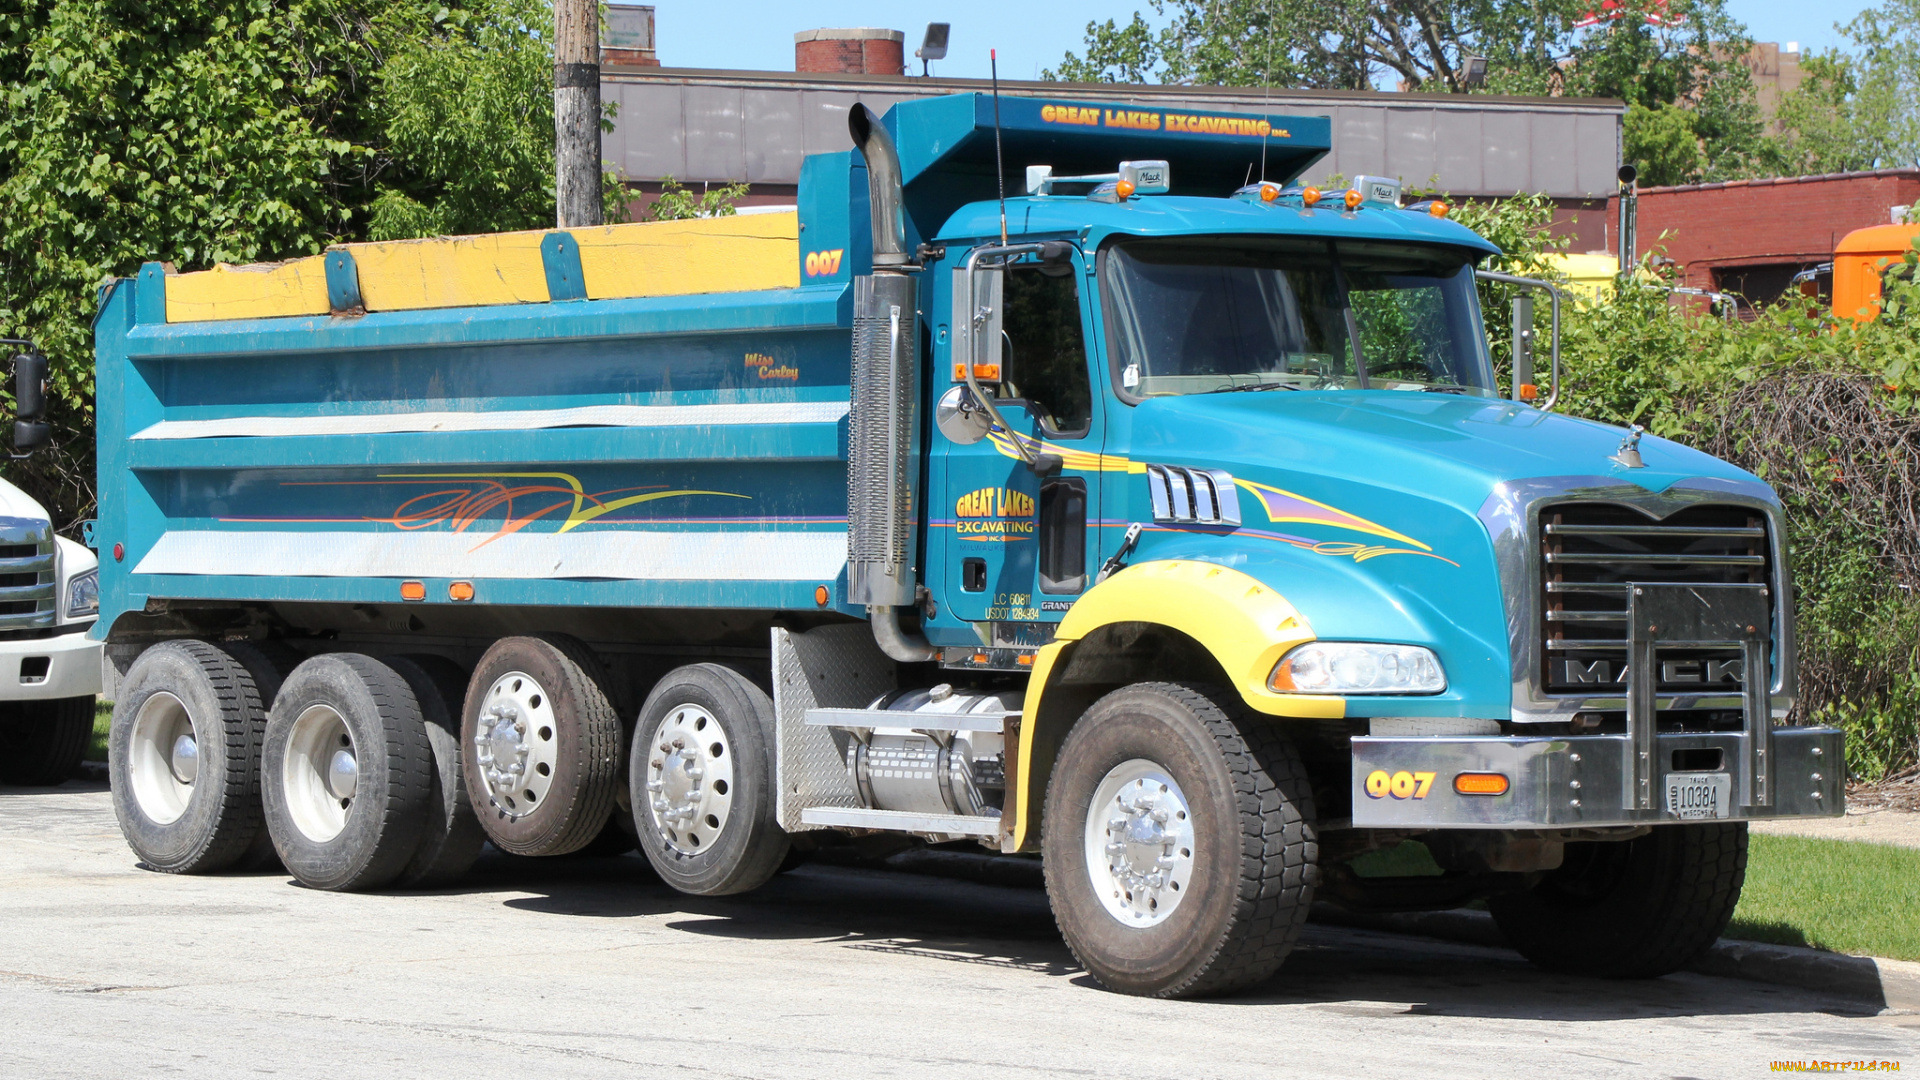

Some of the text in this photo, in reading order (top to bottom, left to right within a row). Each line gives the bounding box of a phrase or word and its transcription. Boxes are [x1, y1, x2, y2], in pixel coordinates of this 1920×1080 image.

[1041, 104, 1291, 138] GREAT LAKES EXCAVATING INC.
[1139, 172, 1161, 182] Mack
[1373, 186, 1393, 198] Mack
[805, 249, 843, 278] 007
[745, 353, 774, 367] Miss
[758, 364, 799, 381] Carley
[956, 487, 1035, 518] GREAT LAKES
[956, 521, 1034, 533] EXCAVATING
[959, 544, 1012, 552] MILWAUKEE
[993, 593, 1031, 606] LC 60811
[1041, 601, 1074, 610] GRANIT
[985, 607, 1010, 619] USDOT
[1565, 660, 1743, 683] MCK
[1364, 769, 1437, 800] 007
[1680, 785, 1717, 808] 10384
